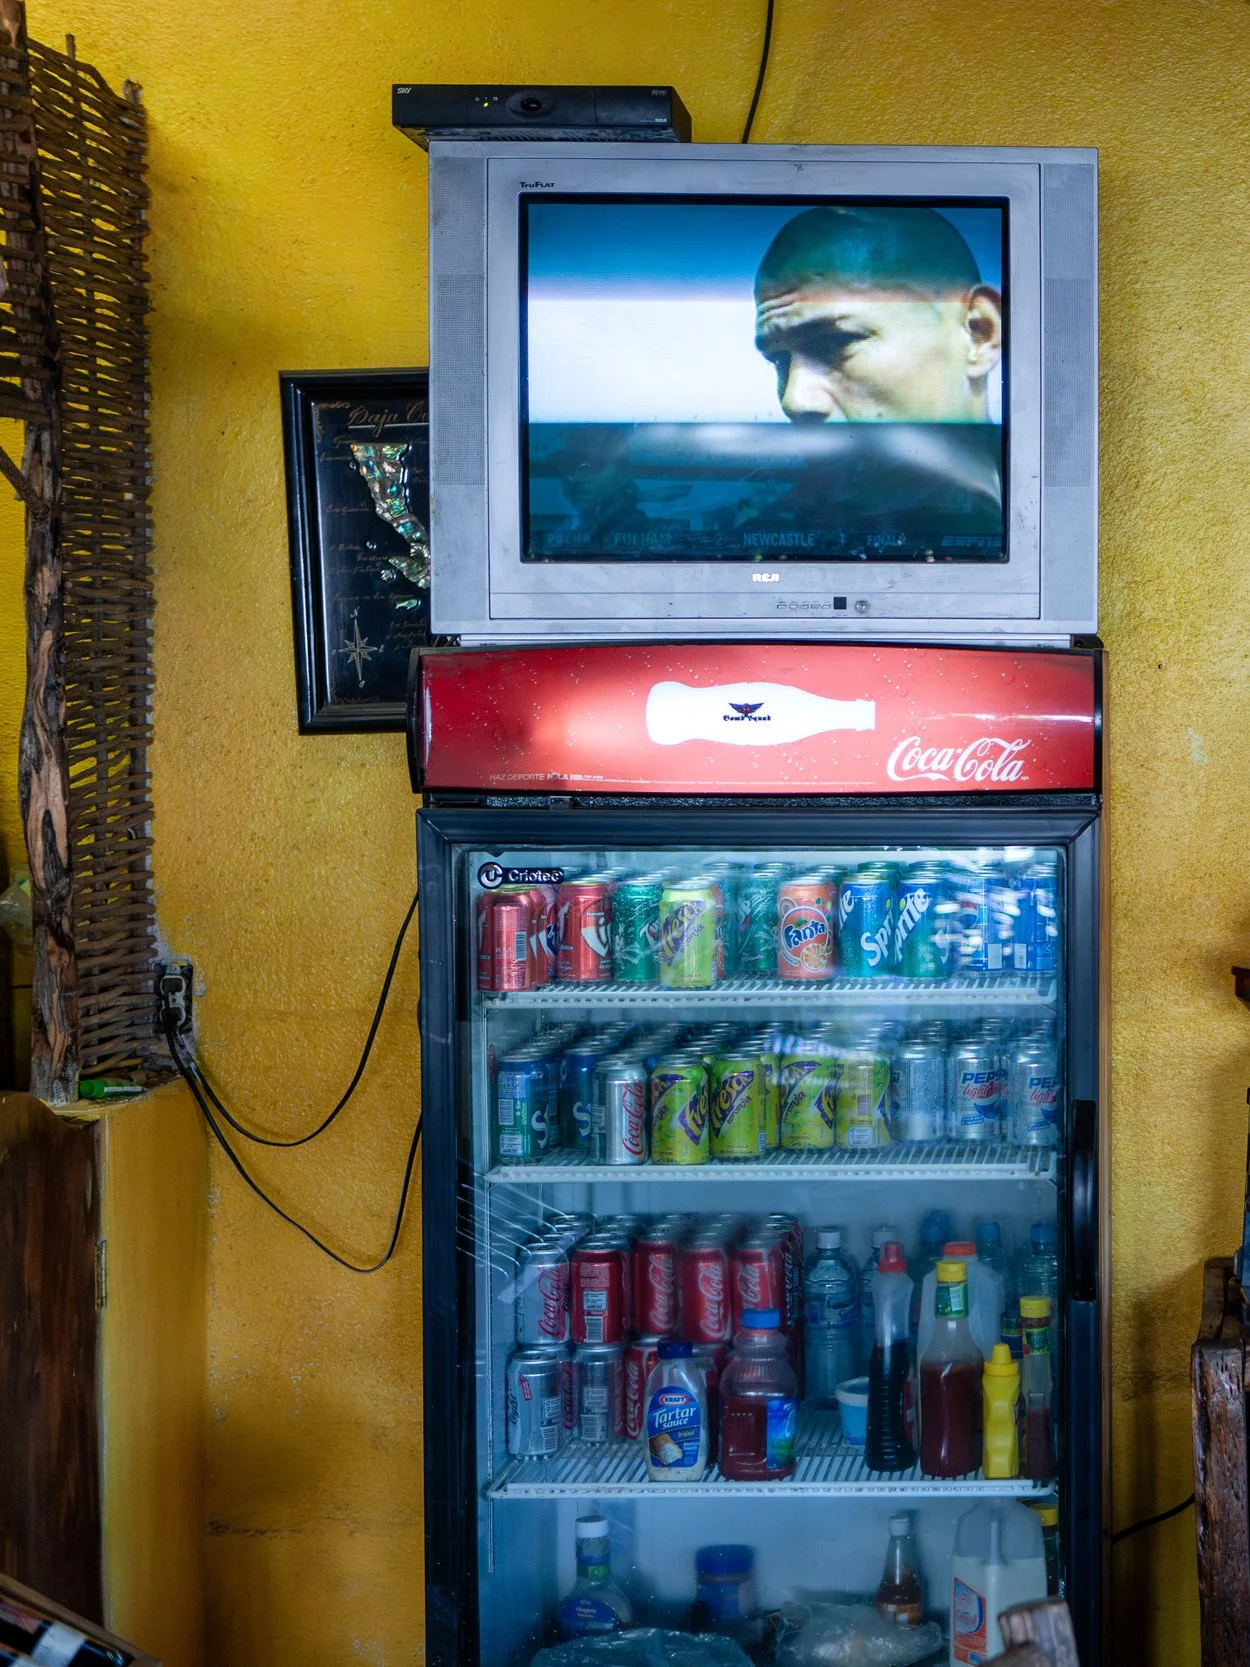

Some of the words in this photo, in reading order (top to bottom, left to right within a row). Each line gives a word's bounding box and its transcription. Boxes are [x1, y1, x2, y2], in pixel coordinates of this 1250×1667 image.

[347, 404, 400, 438] Baja
[743, 533, 815, 547] NEWCASTLE
[752, 573, 780, 582] RCA
[887, 736, 1032, 782] Coca-Cola
[507, 773, 545, 781] DEPORTE
[784, 921, 826, 951] Fanta
[700, 1262, 724, 1339] Coca-Cola
[664, 1395, 685, 1403] KRAFT
[653, 1407, 696, 1429] Tartar
[662, 1417, 689, 1430] sauce
